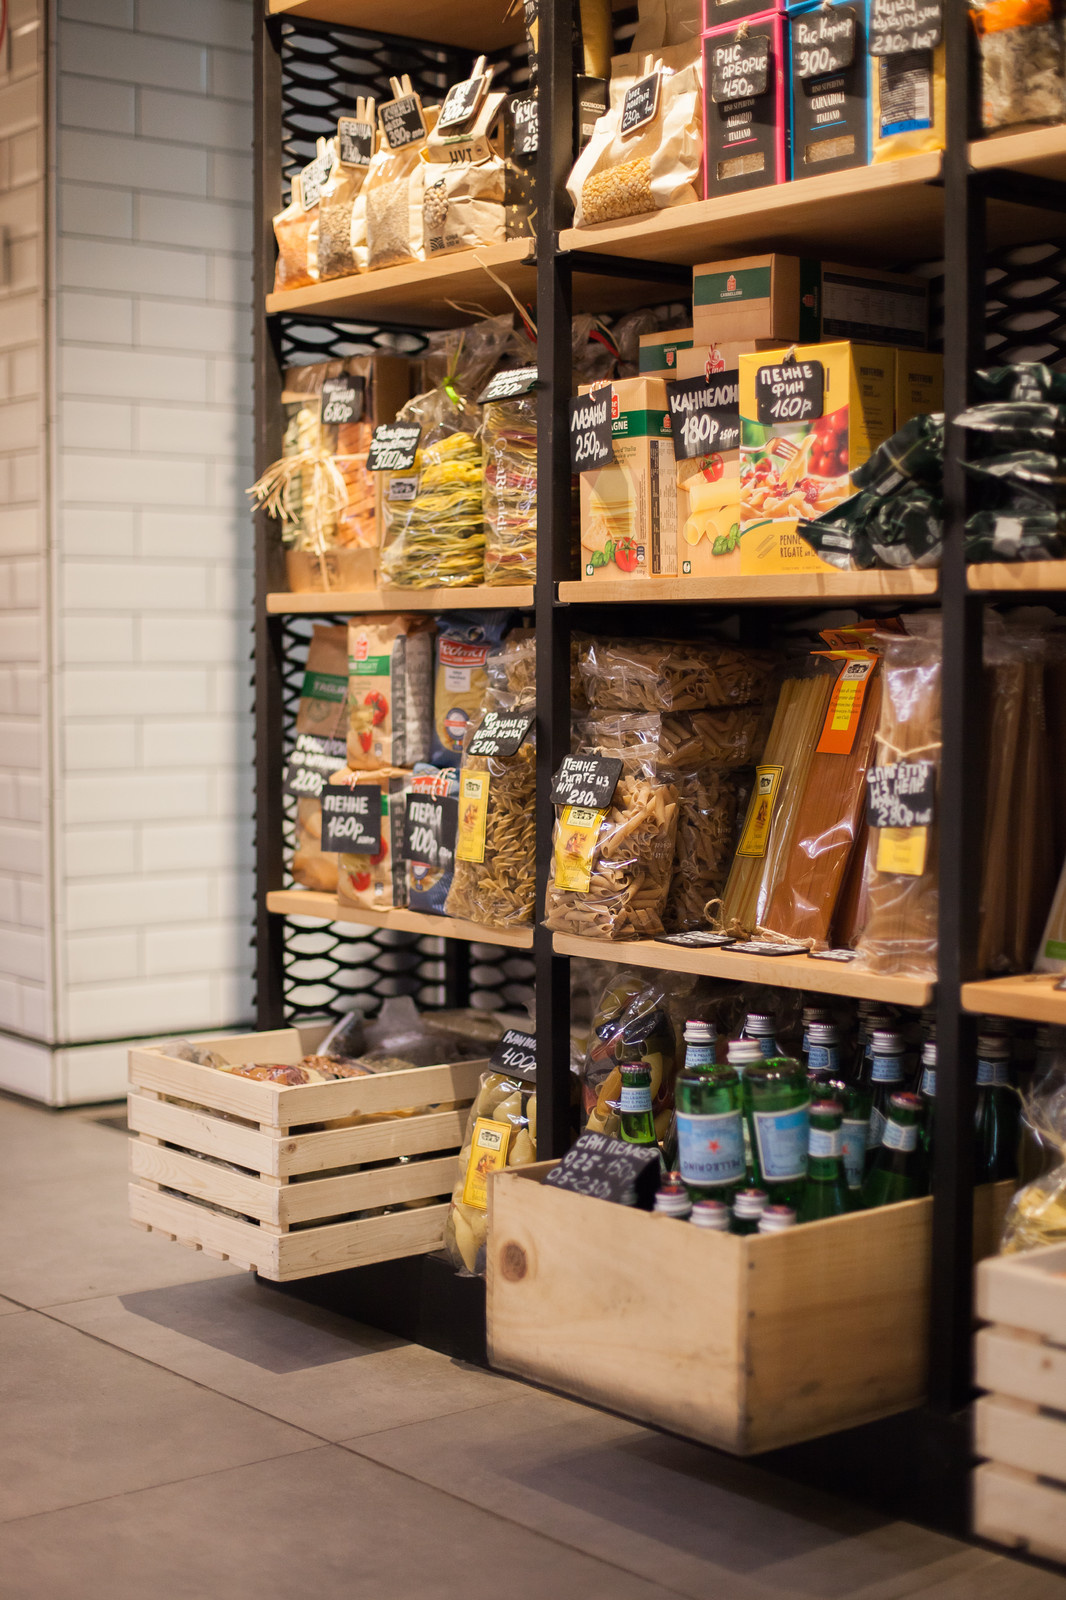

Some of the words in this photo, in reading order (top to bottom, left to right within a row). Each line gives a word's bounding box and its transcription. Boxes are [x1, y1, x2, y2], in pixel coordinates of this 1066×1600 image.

[797, 24, 817, 44] Рис
[716, 44, 741, 67] РИС
[800, 47, 837, 77] 300р
[722, 78, 754, 98] 450р
[816, 109, 840, 124] ITALIANO
[728, 128, 751, 142] ITALIANO
[761, 365, 813, 385] ПЕННЕ
[772, 381, 804, 397] ФИН
[571, 401, 607, 432] ЛАЗАНЬЯ
[770, 398, 812, 419] 160р
[680, 414, 719, 445] 180р
[575, 431, 600, 462] 250р
[780, 548, 803, 558] RIGATE
[469, 740, 499, 756] 280р
[562, 757, 598, 772] ПЕННЕ
[324, 795, 369, 814] ПЕННЕ
[566, 788, 598, 807] 280р
[328, 816, 364, 841] 160р
[502, 1048, 537, 1073] 400р
